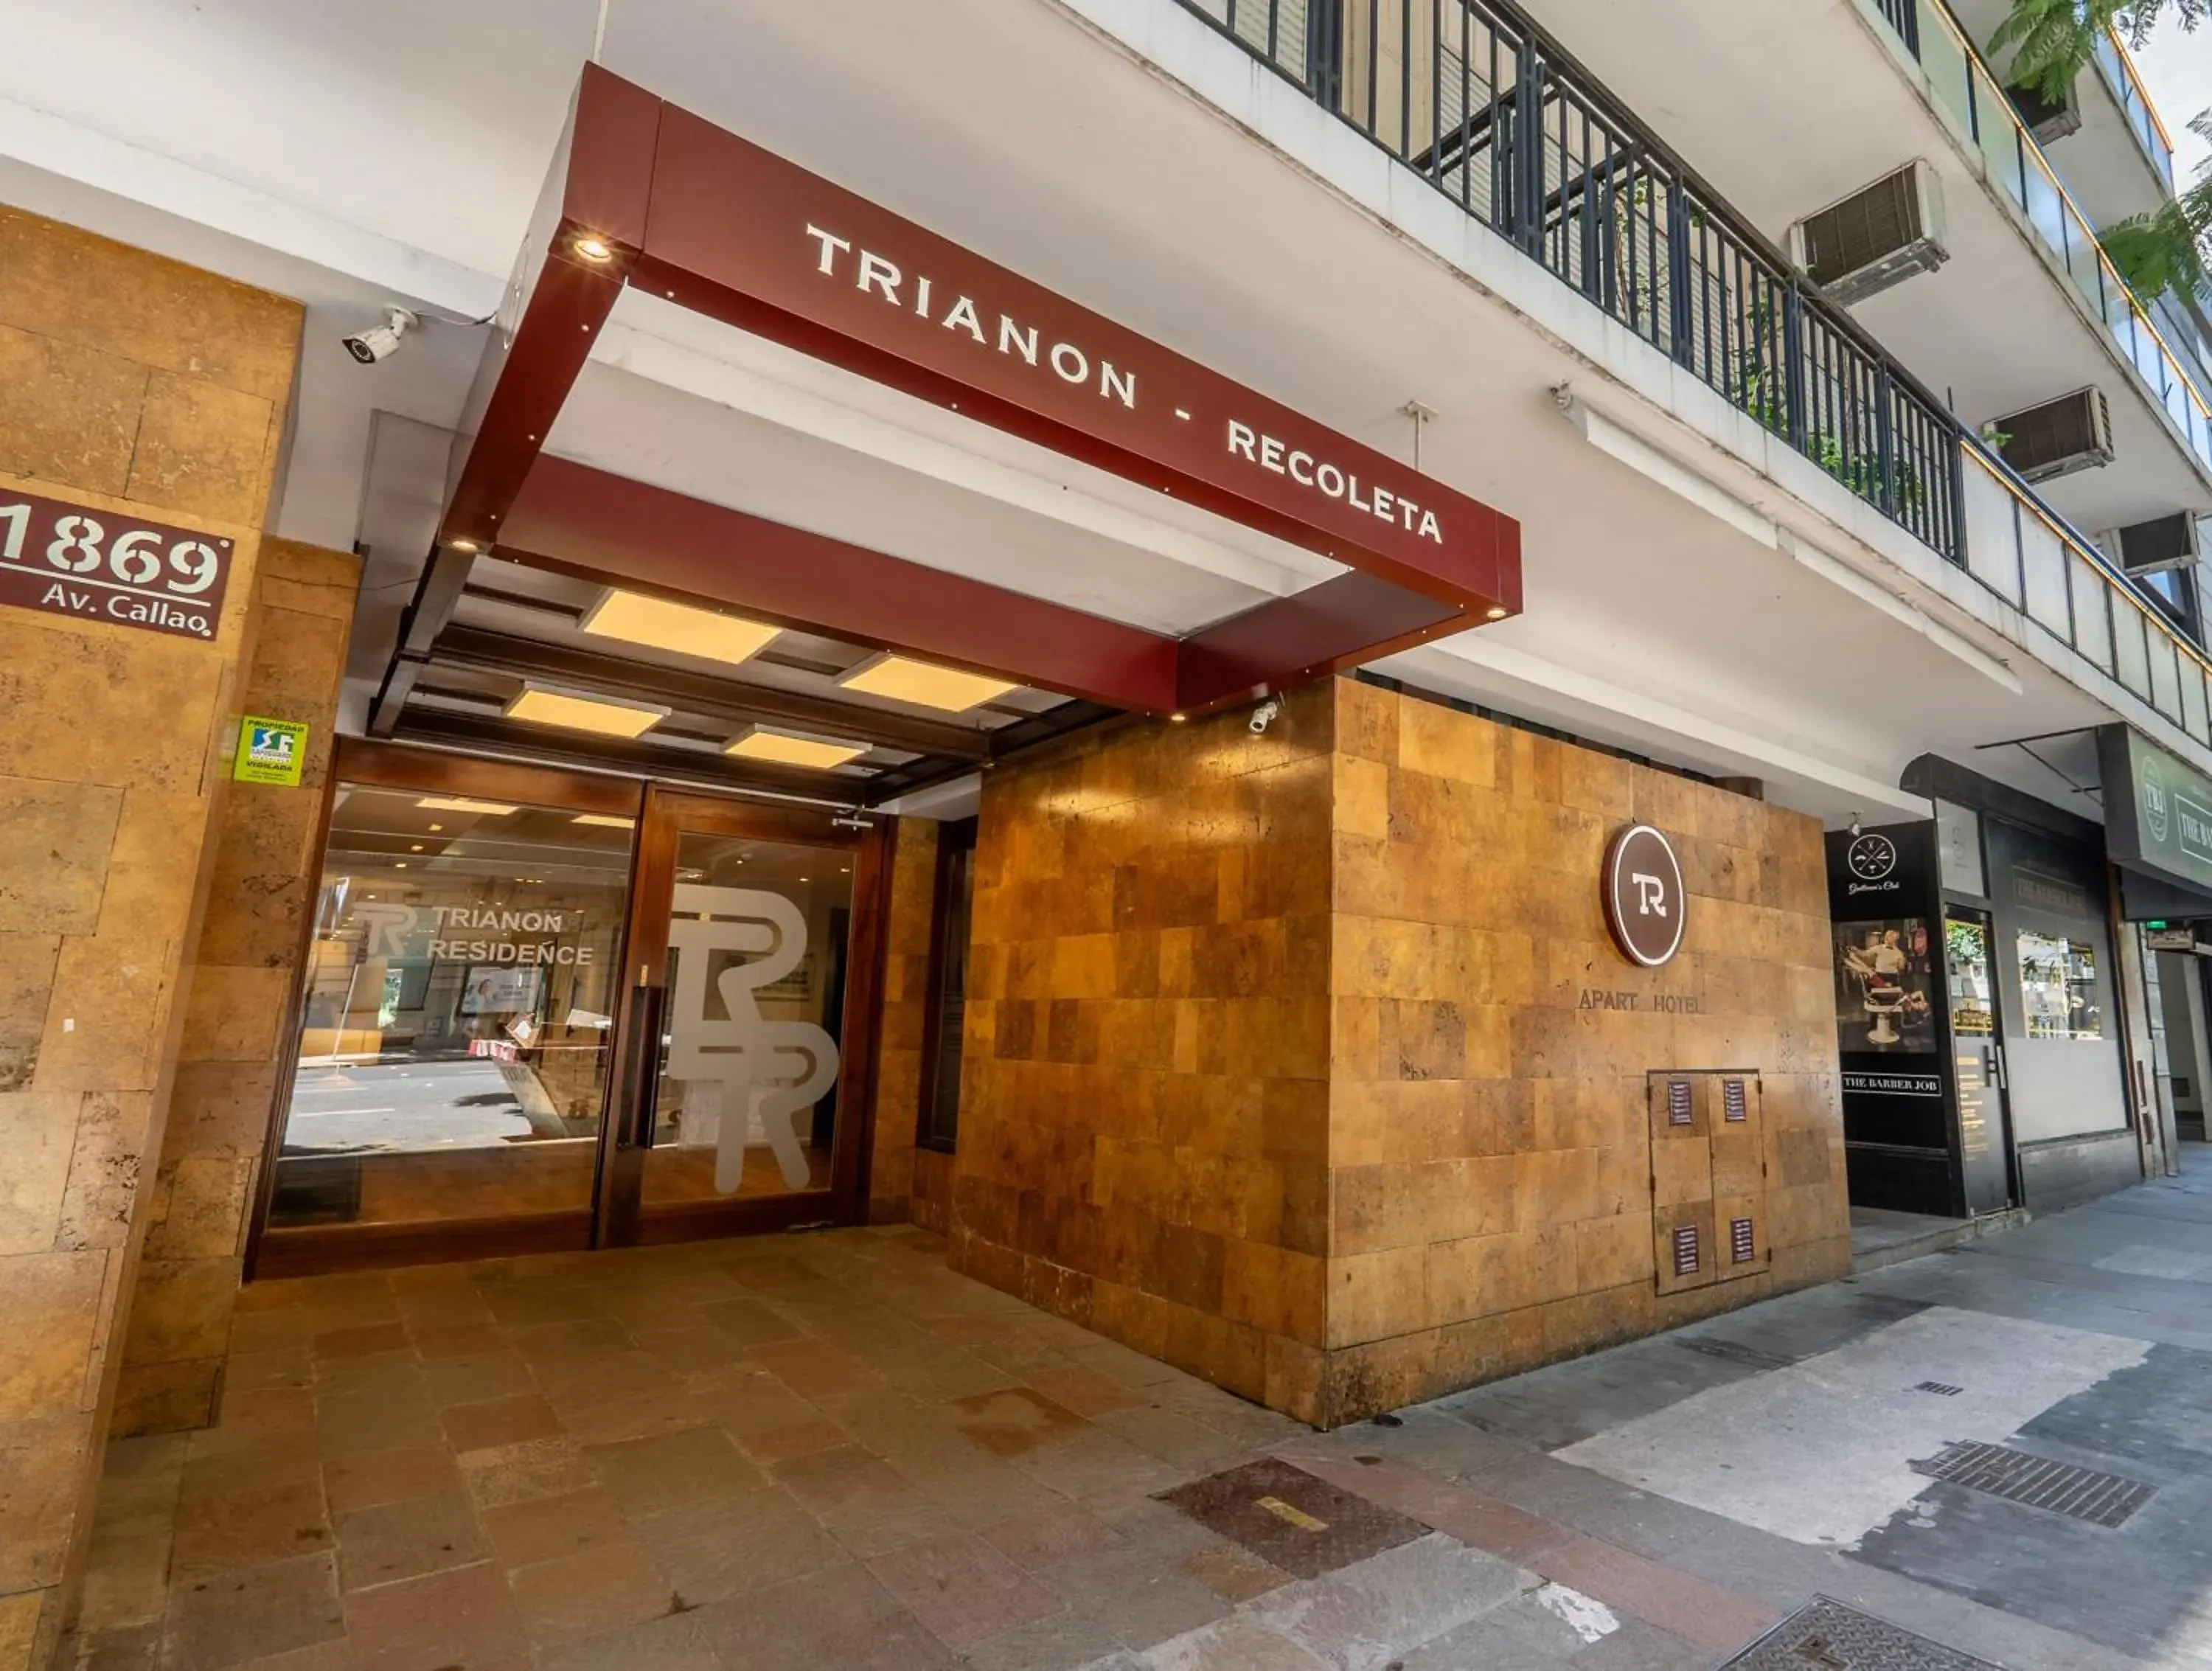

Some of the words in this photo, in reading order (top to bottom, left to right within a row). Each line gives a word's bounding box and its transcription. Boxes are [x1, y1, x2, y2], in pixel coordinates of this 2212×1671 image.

[806, 223, 1136, 409] TRIANON
[1227, 418, 1443, 545] RECOLETA
[0, 504, 218, 594] 1869
[41, 583, 96, 613] Av.
[107, 595, 207, 633] Callao
[431, 906, 563, 934] TRIANON
[426, 937, 594, 967] RESIDENCE
[1579, 989, 1638, 1010] APART
[1654, 994, 1704, 1014] HOTEL
[1844, 1077, 1866, 1088] THE
[1869, 1079, 1912, 1089] BARBER
[1915, 1080, 1937, 1091] JOB
